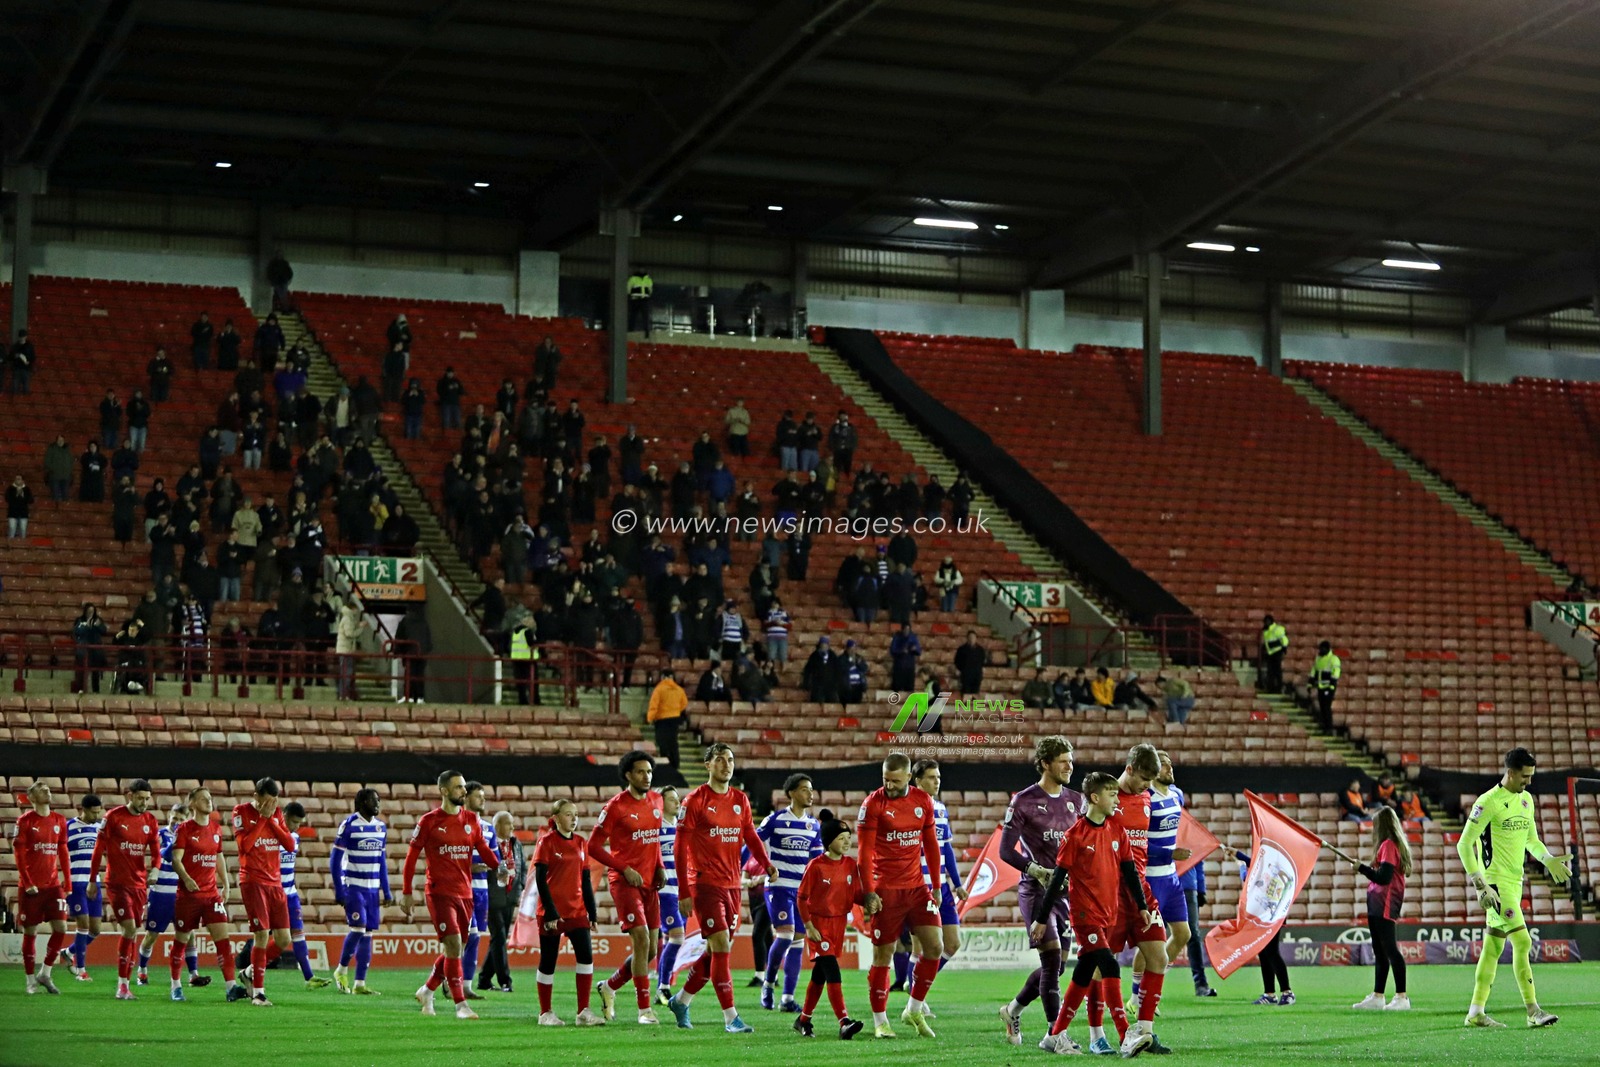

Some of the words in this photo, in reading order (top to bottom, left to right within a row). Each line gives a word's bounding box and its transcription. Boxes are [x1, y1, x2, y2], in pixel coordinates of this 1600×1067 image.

[401, 562, 418, 582] 2
[1046, 587, 1061, 606] 3
[1043, 829, 1064, 841] glee
[439, 844, 470, 855] gleeson
[1416, 928, 1454, 943] CAR
[372, 938, 400, 954] EW
[1294, 943, 1319, 964] sky
[1323, 944, 1349, 961] bet
[1446, 941, 1469, 962] sky
[1544, 942, 1567, 957] bet
